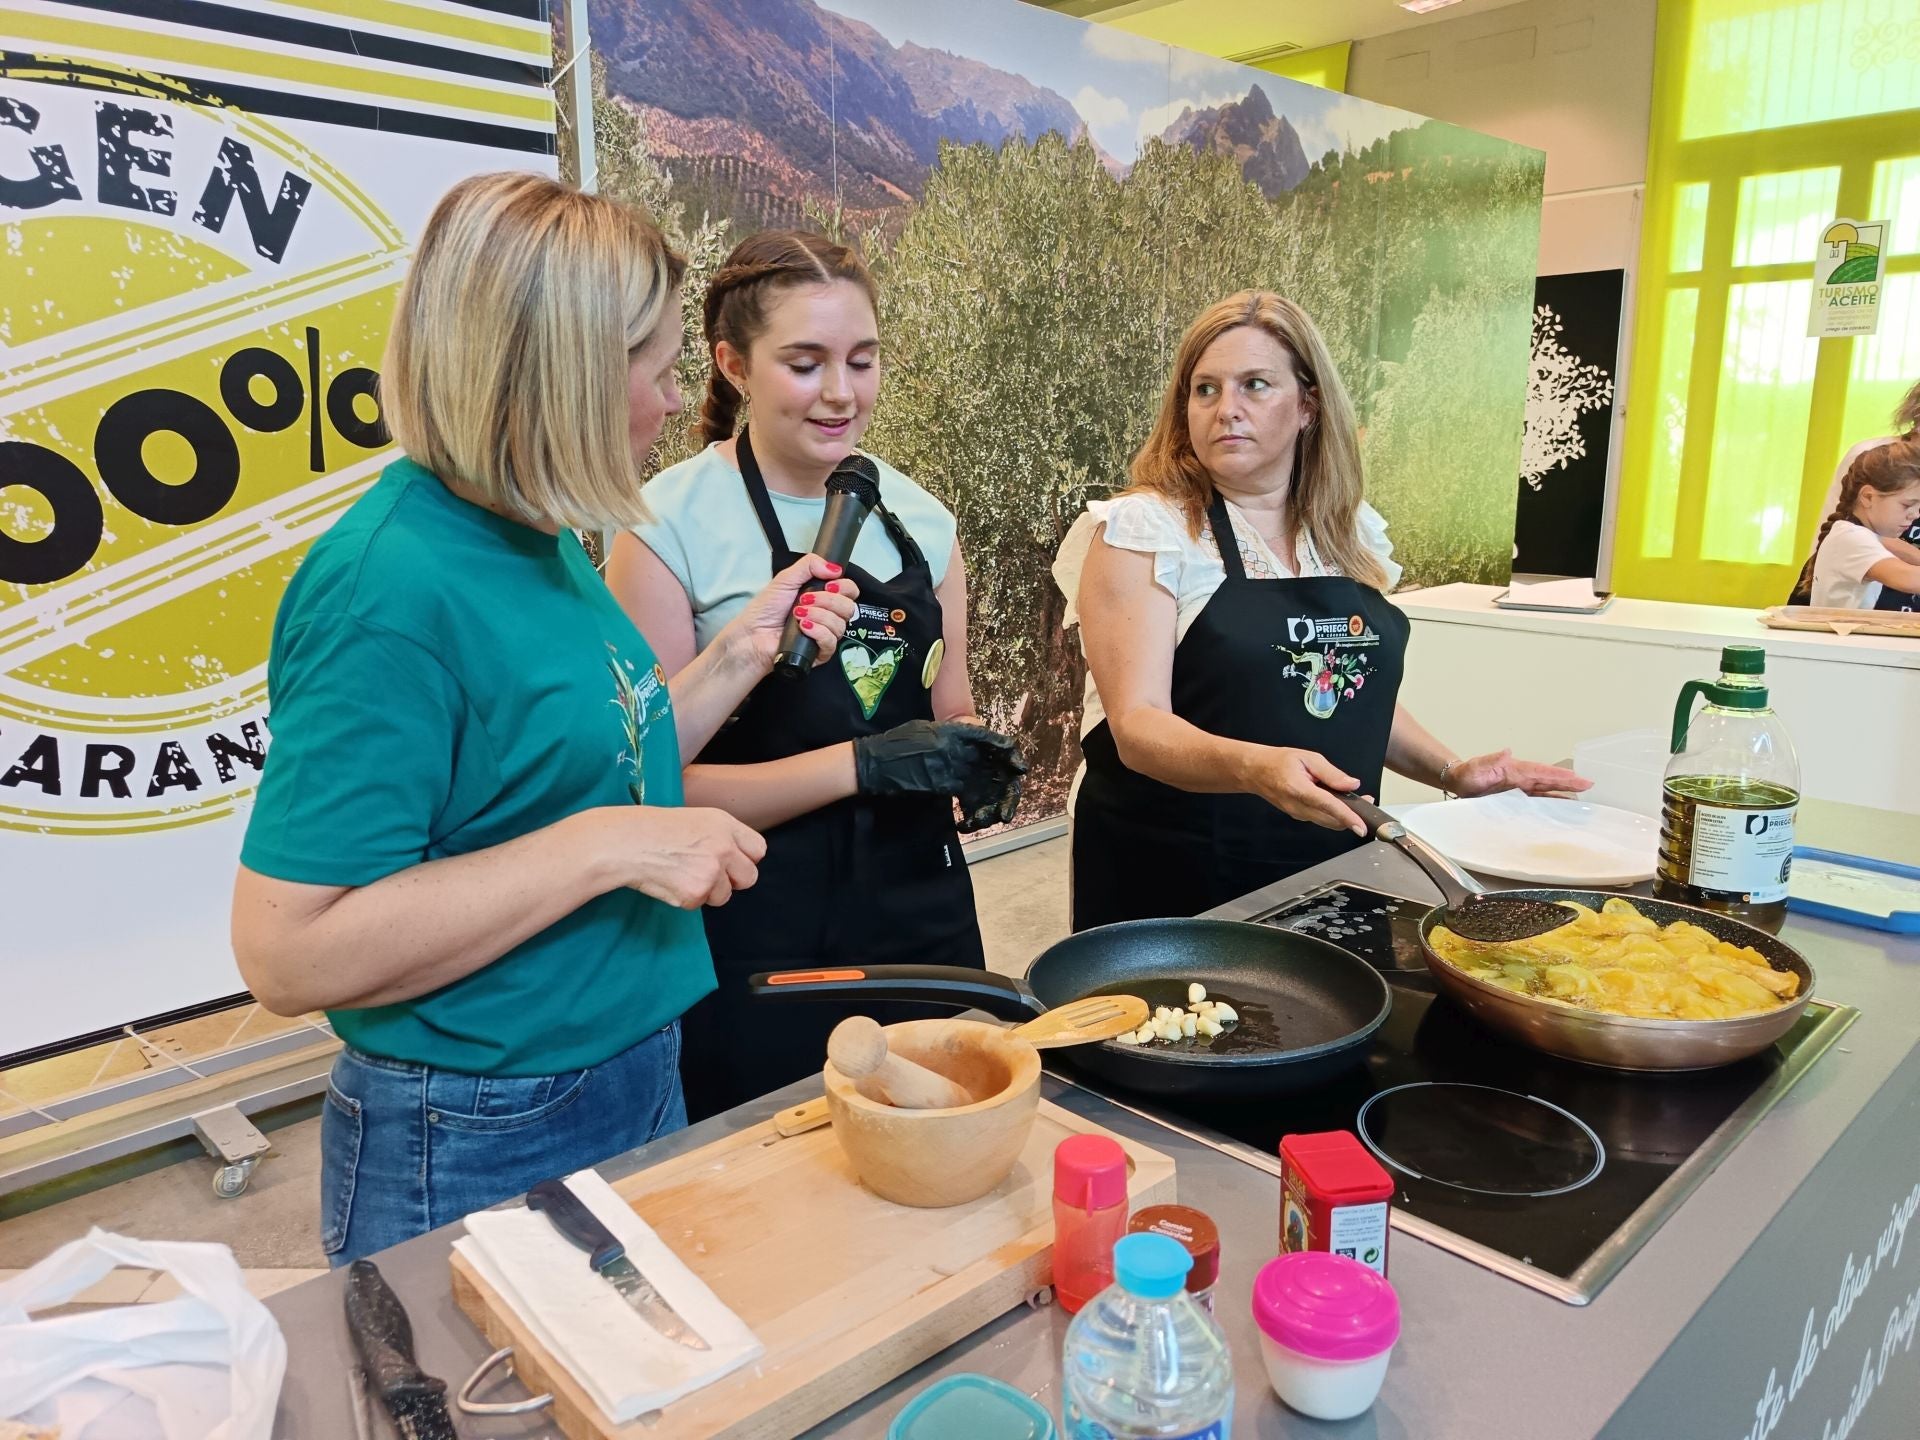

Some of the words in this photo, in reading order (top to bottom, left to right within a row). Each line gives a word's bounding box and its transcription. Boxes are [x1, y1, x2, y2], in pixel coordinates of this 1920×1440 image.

[0, 96, 312, 264] GEN
[1819, 285, 1879, 299] TURISMO
[1829, 294, 1877, 307] ACEITE
[860, 608, 889, 618] PRIEGO
[1315, 623, 1348, 633] PRIEGO
[0, 716, 268, 798] ARAN
[1769, 818, 1791, 827] PRIEGO
[1788, 1307, 1819, 1402] de
[1823, 1252, 1873, 1350] oliva
[1875, 1183, 1920, 1272] virge
